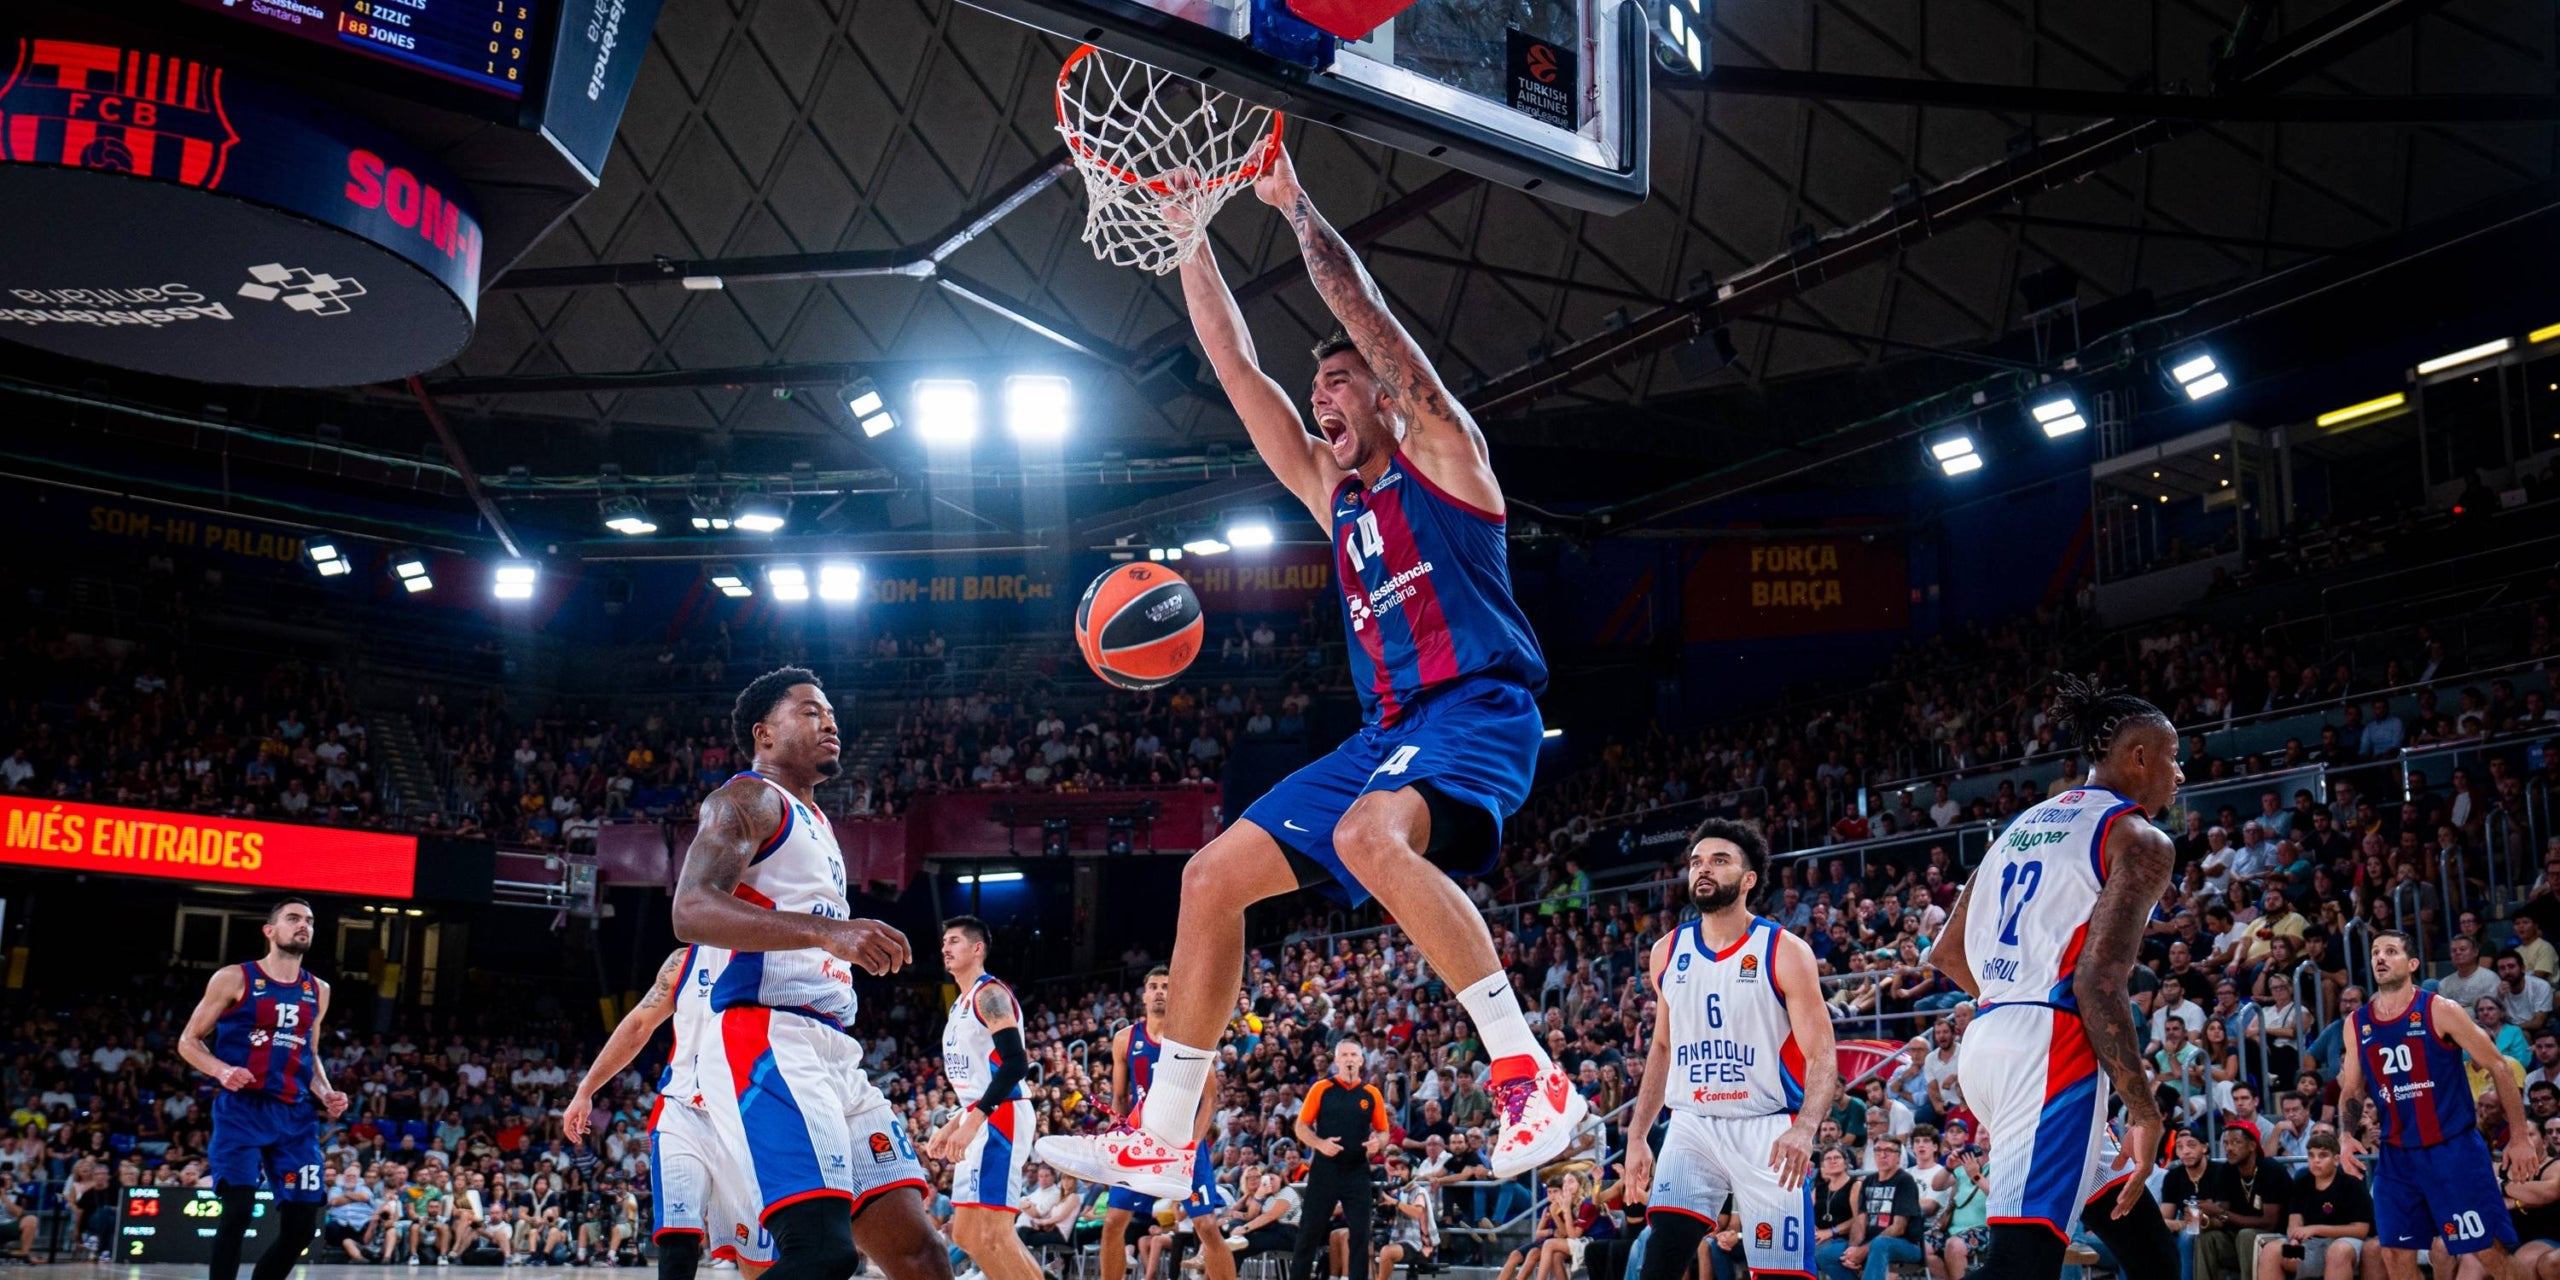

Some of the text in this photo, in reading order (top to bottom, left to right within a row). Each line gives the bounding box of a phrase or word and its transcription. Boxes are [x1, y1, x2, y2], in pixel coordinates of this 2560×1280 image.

[518, 7, 527, 19] 3
[354, 0, 371, 15] 41
[372, 4, 411, 27] ZIZIC
[511, 47, 520, 60] 9
[515, 27, 524, 40] 8
[348, 20, 517, 80] 88 JONES 1 8
[1518, 76, 1568, 104] TURKISH
[1518, 90, 1568, 116] AIRLINES
[1516, 100, 1569, 128] EuroLeague
[89, 505, 197, 547] SOM-HI
[1346, 509, 1385, 573] 14
[1751, 545, 1839, 576] FORÇA
[869, 577, 957, 603] SOM-HI
[1237, 564, 1329, 591] PALAU!
[1369, 561, 1434, 605] Assistència
[1372, 584, 1417, 618] Sanitària
[1752, 580, 1843, 611] BARÇA
[6, 804, 264, 870] MÉS ENTRADES
[1997, 860, 2043, 946] 12
[275, 1003, 300, 1028] 13
[1707, 993, 1723, 1029] 6
[1677, 1039, 1755, 1067] ANADOLU
[2378, 1044, 2413, 1075] 20
[1690, 1063, 1746, 1083] EFES
[2393, 1080, 2435, 1093] Assistència
[1706, 1089, 1748, 1102] corendon
[299, 1164, 321, 1191] 13
[128, 1199, 159, 1217] 54
[183, 1199, 223, 1217] 4:2
[1783, 1216, 1799, 1252] 6
[2452, 1210, 2486, 1240] 20
[130, 1240, 144, 1255] 2
